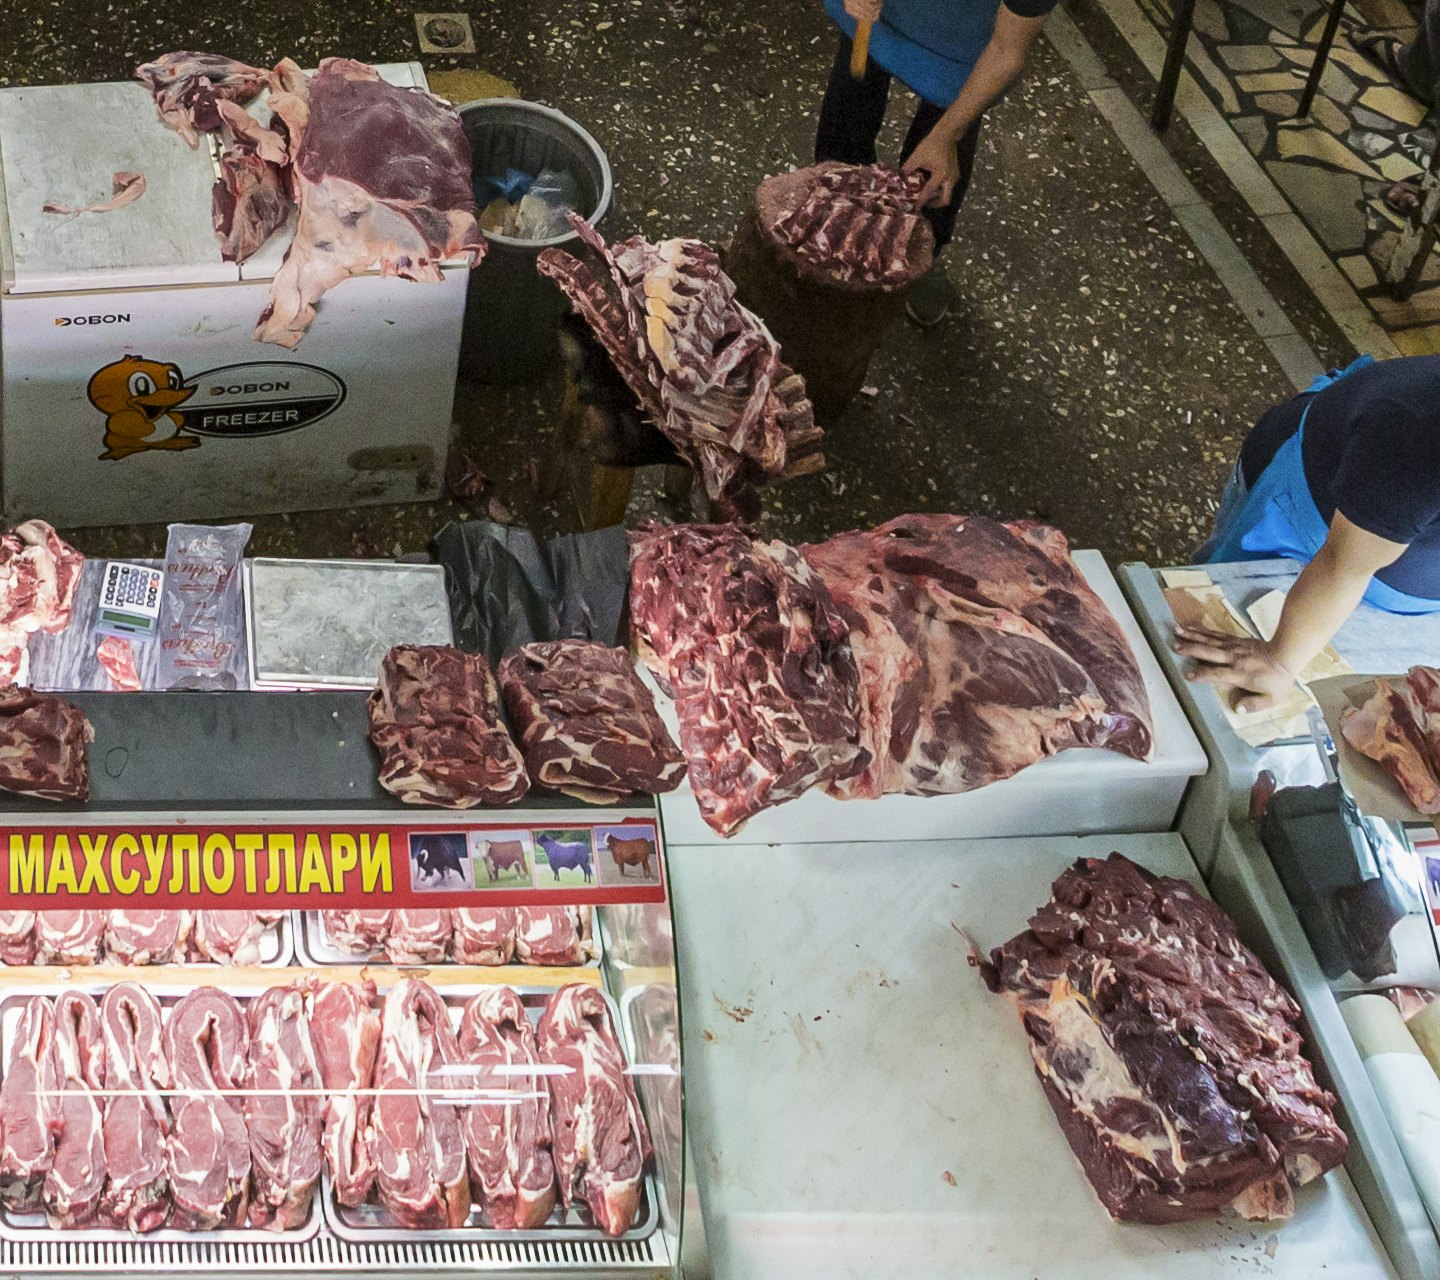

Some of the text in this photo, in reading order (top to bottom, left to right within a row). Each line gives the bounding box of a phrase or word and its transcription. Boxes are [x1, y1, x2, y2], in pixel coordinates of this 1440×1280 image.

[54, 313, 132, 328] DOBON
[209, 380, 291, 396] DOBON
[203, 409, 300, 428] FREEZER
[8, 832, 395, 895] МАХСУЛОТЛАРИ
